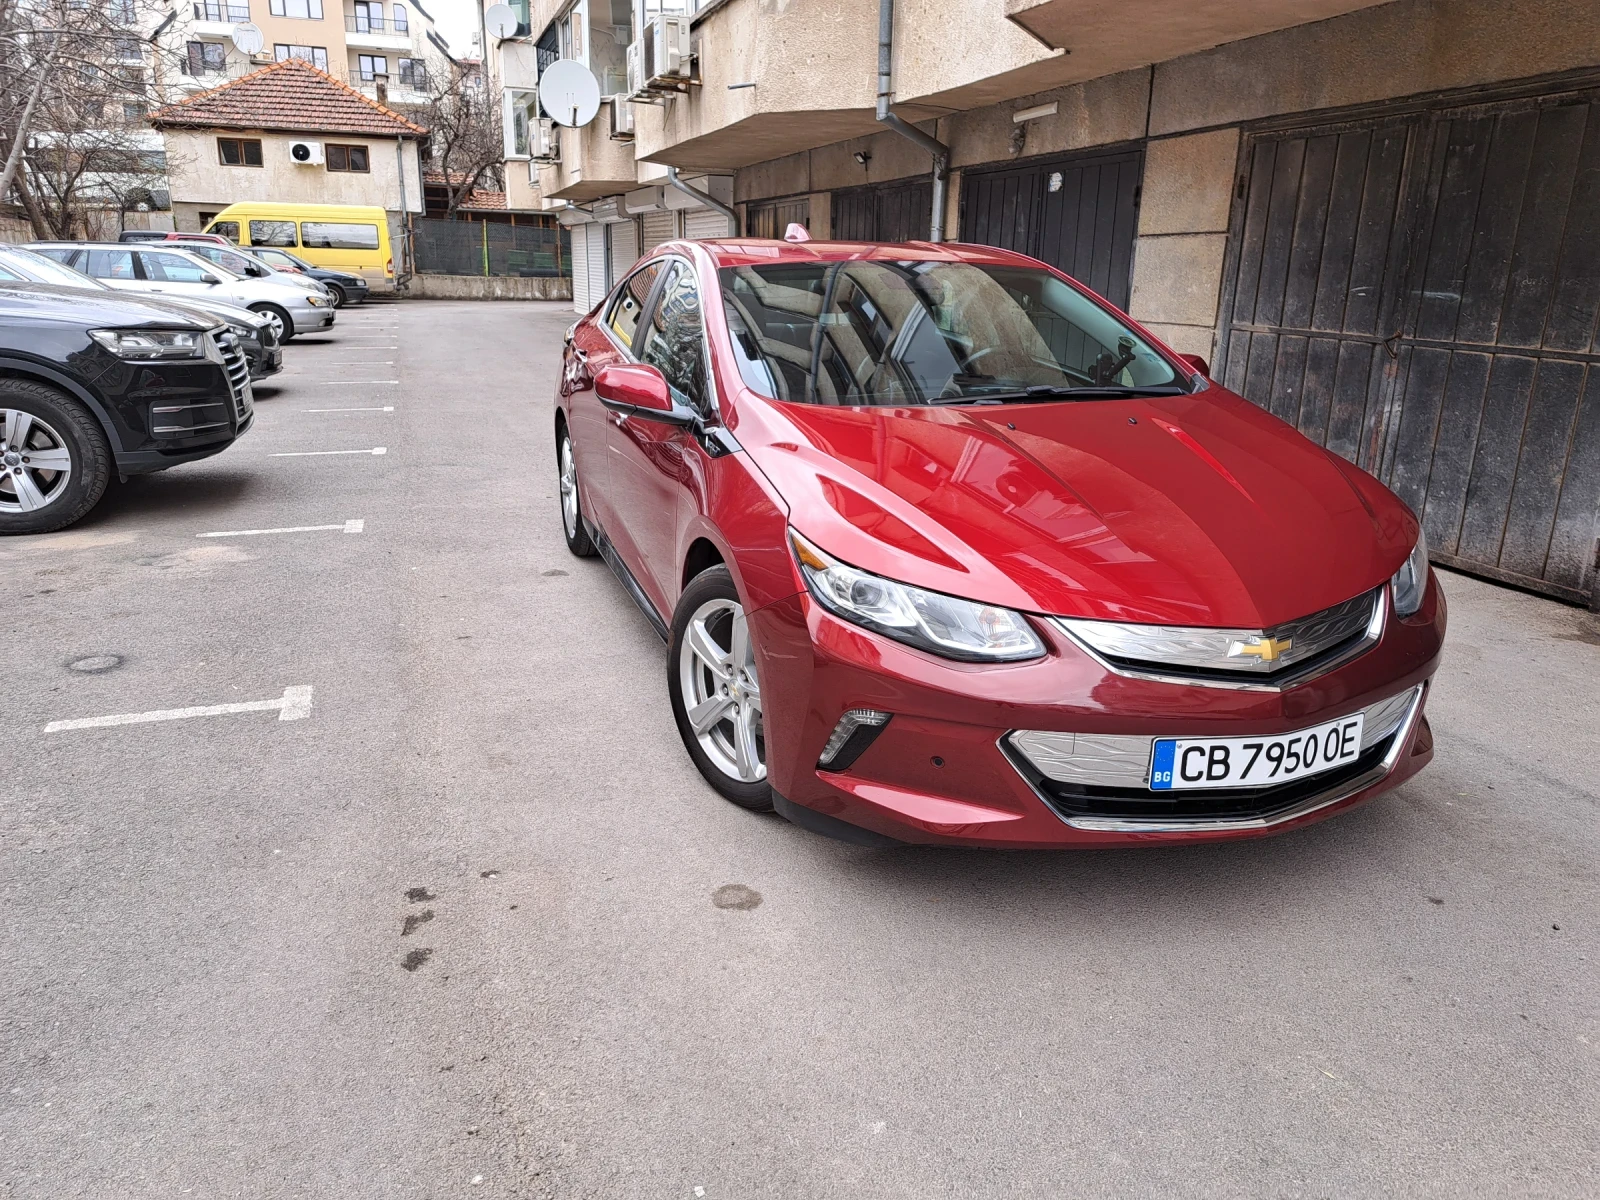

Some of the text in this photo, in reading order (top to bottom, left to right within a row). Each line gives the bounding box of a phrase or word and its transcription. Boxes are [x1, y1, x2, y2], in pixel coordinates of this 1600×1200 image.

[1180, 721, 1358, 782] CB 7950 OE
[1154, 771, 1171, 782] BG
